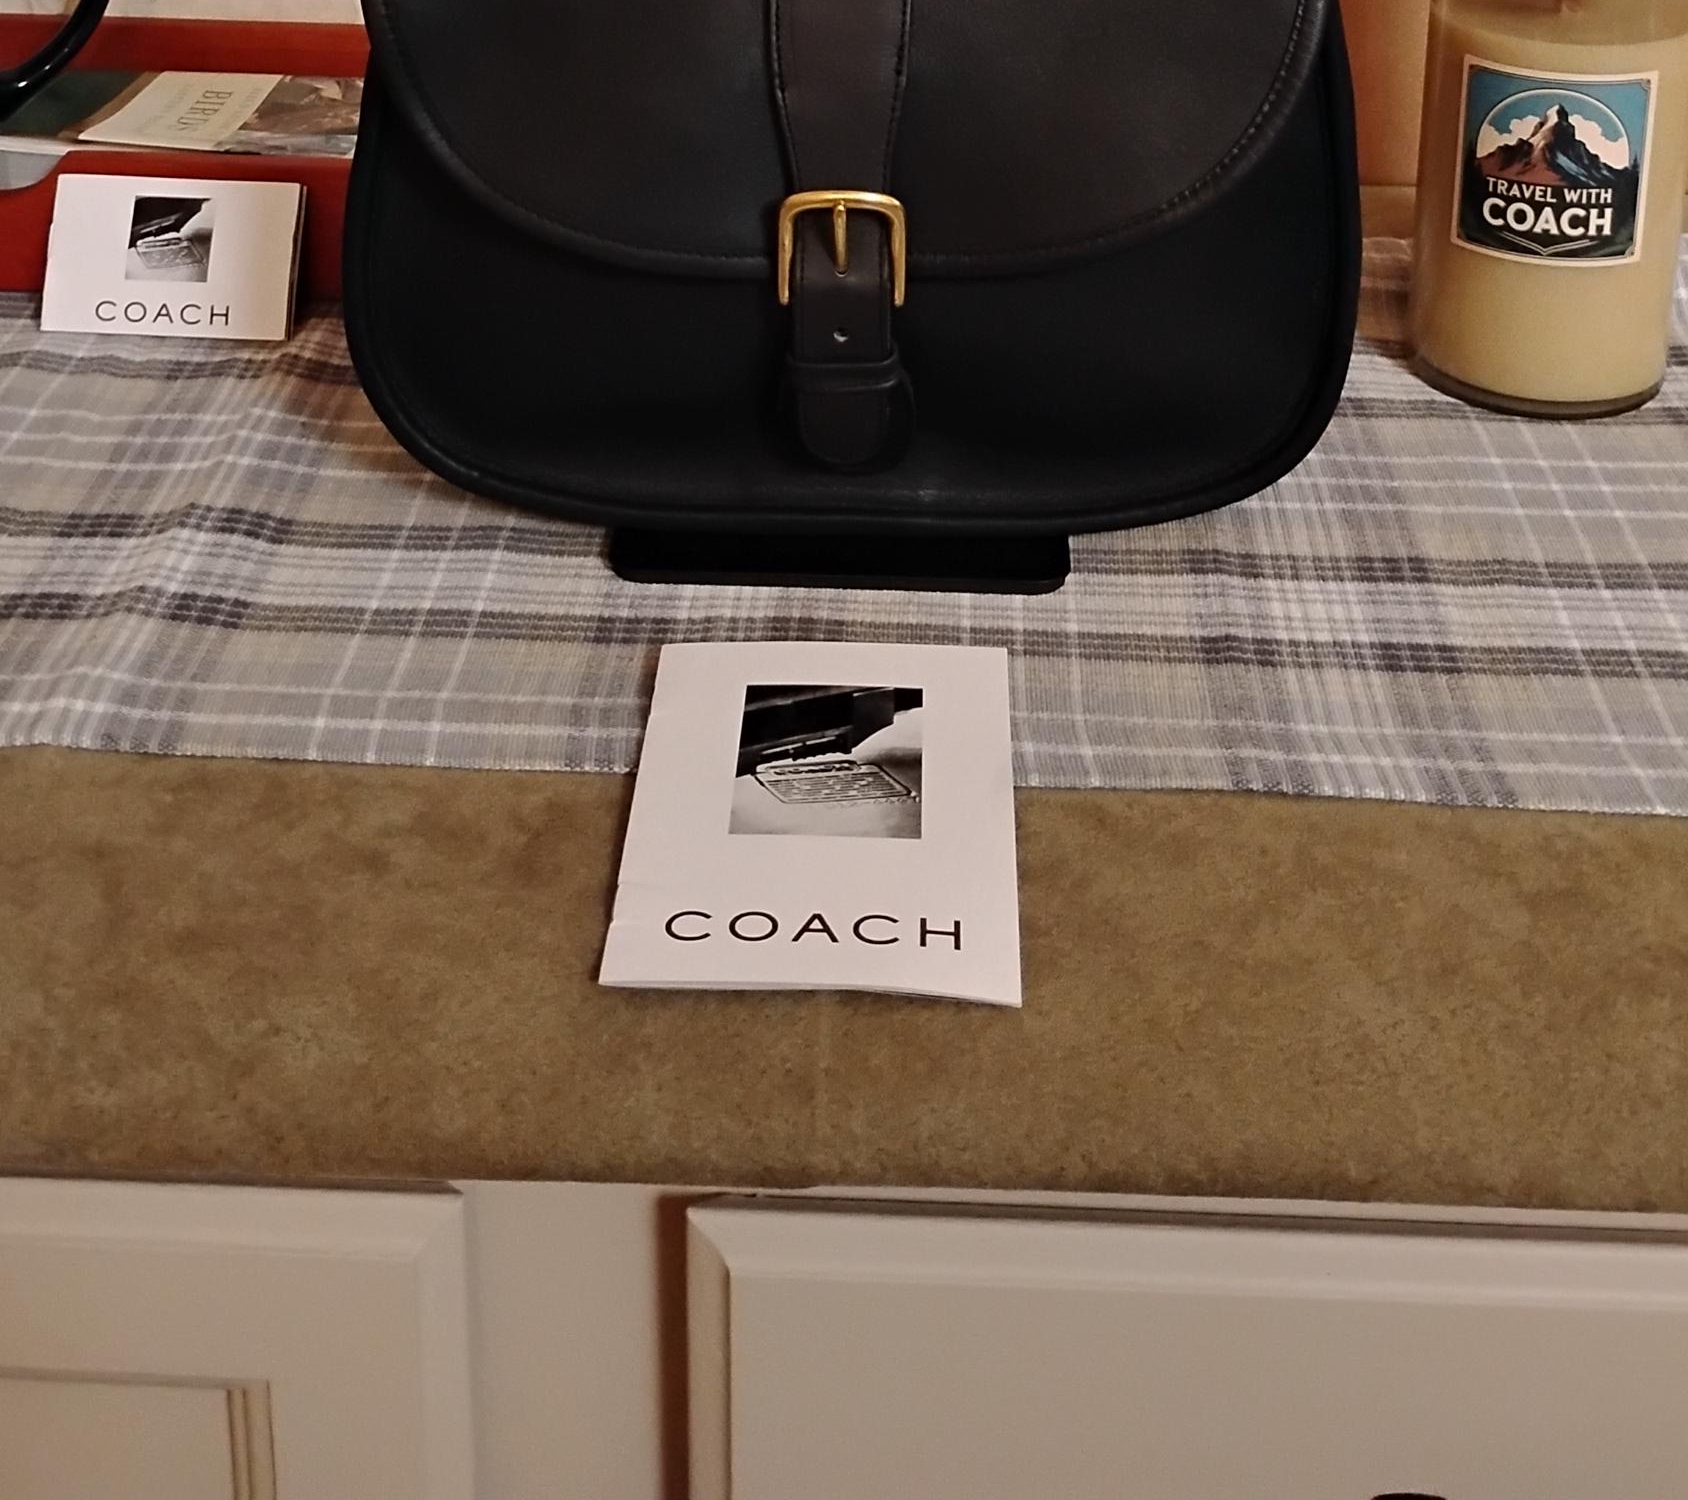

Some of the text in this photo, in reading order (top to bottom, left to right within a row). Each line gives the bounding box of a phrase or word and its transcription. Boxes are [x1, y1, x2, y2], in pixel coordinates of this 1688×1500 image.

[168, 89, 234, 132] BIRDS
[1486, 176, 1613, 204] TRAVEL WITH
[1482, 197, 1614, 237] COACH
[95, 300, 230, 327] COACH
[665, 910, 961, 951] COACH
